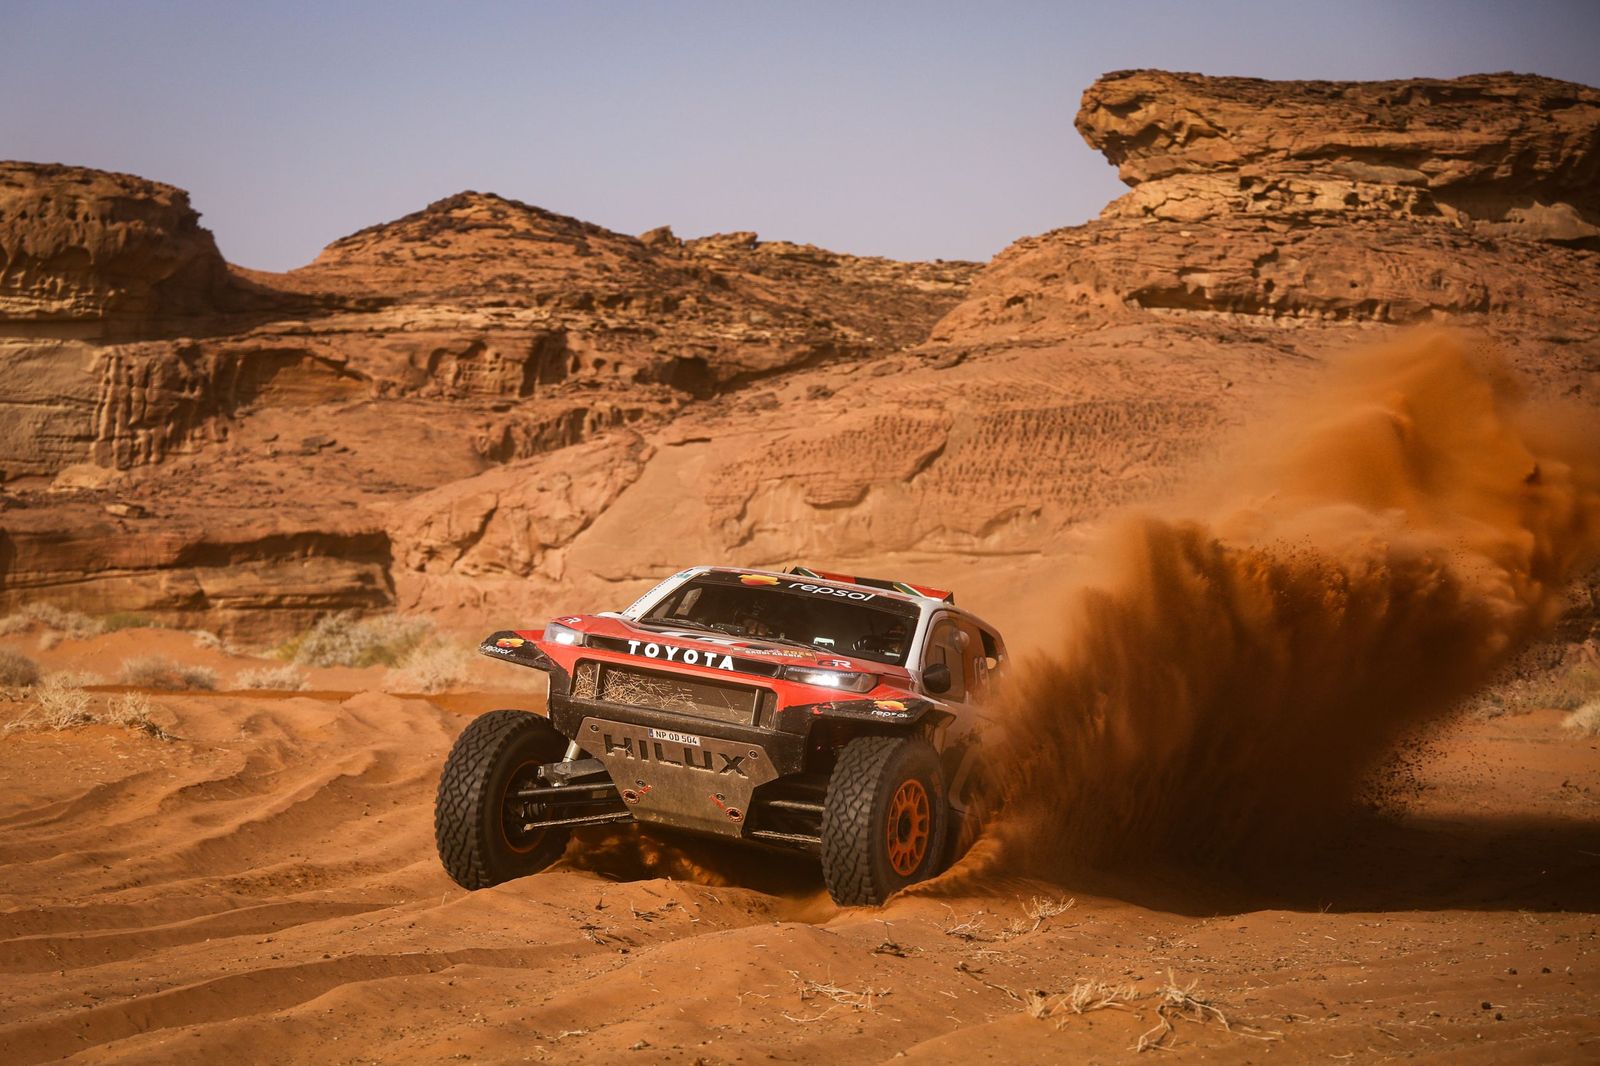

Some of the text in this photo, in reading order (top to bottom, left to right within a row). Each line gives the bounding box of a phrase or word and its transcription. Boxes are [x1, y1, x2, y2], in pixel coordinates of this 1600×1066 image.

[788, 582, 877, 602] repsol
[628, 640, 734, 671] TOYOTA
[817, 659, 852, 669] GR
[655, 730, 667, 739] NP
[681, 735, 698, 745] 504
[604, 733, 749, 779] HILUX
